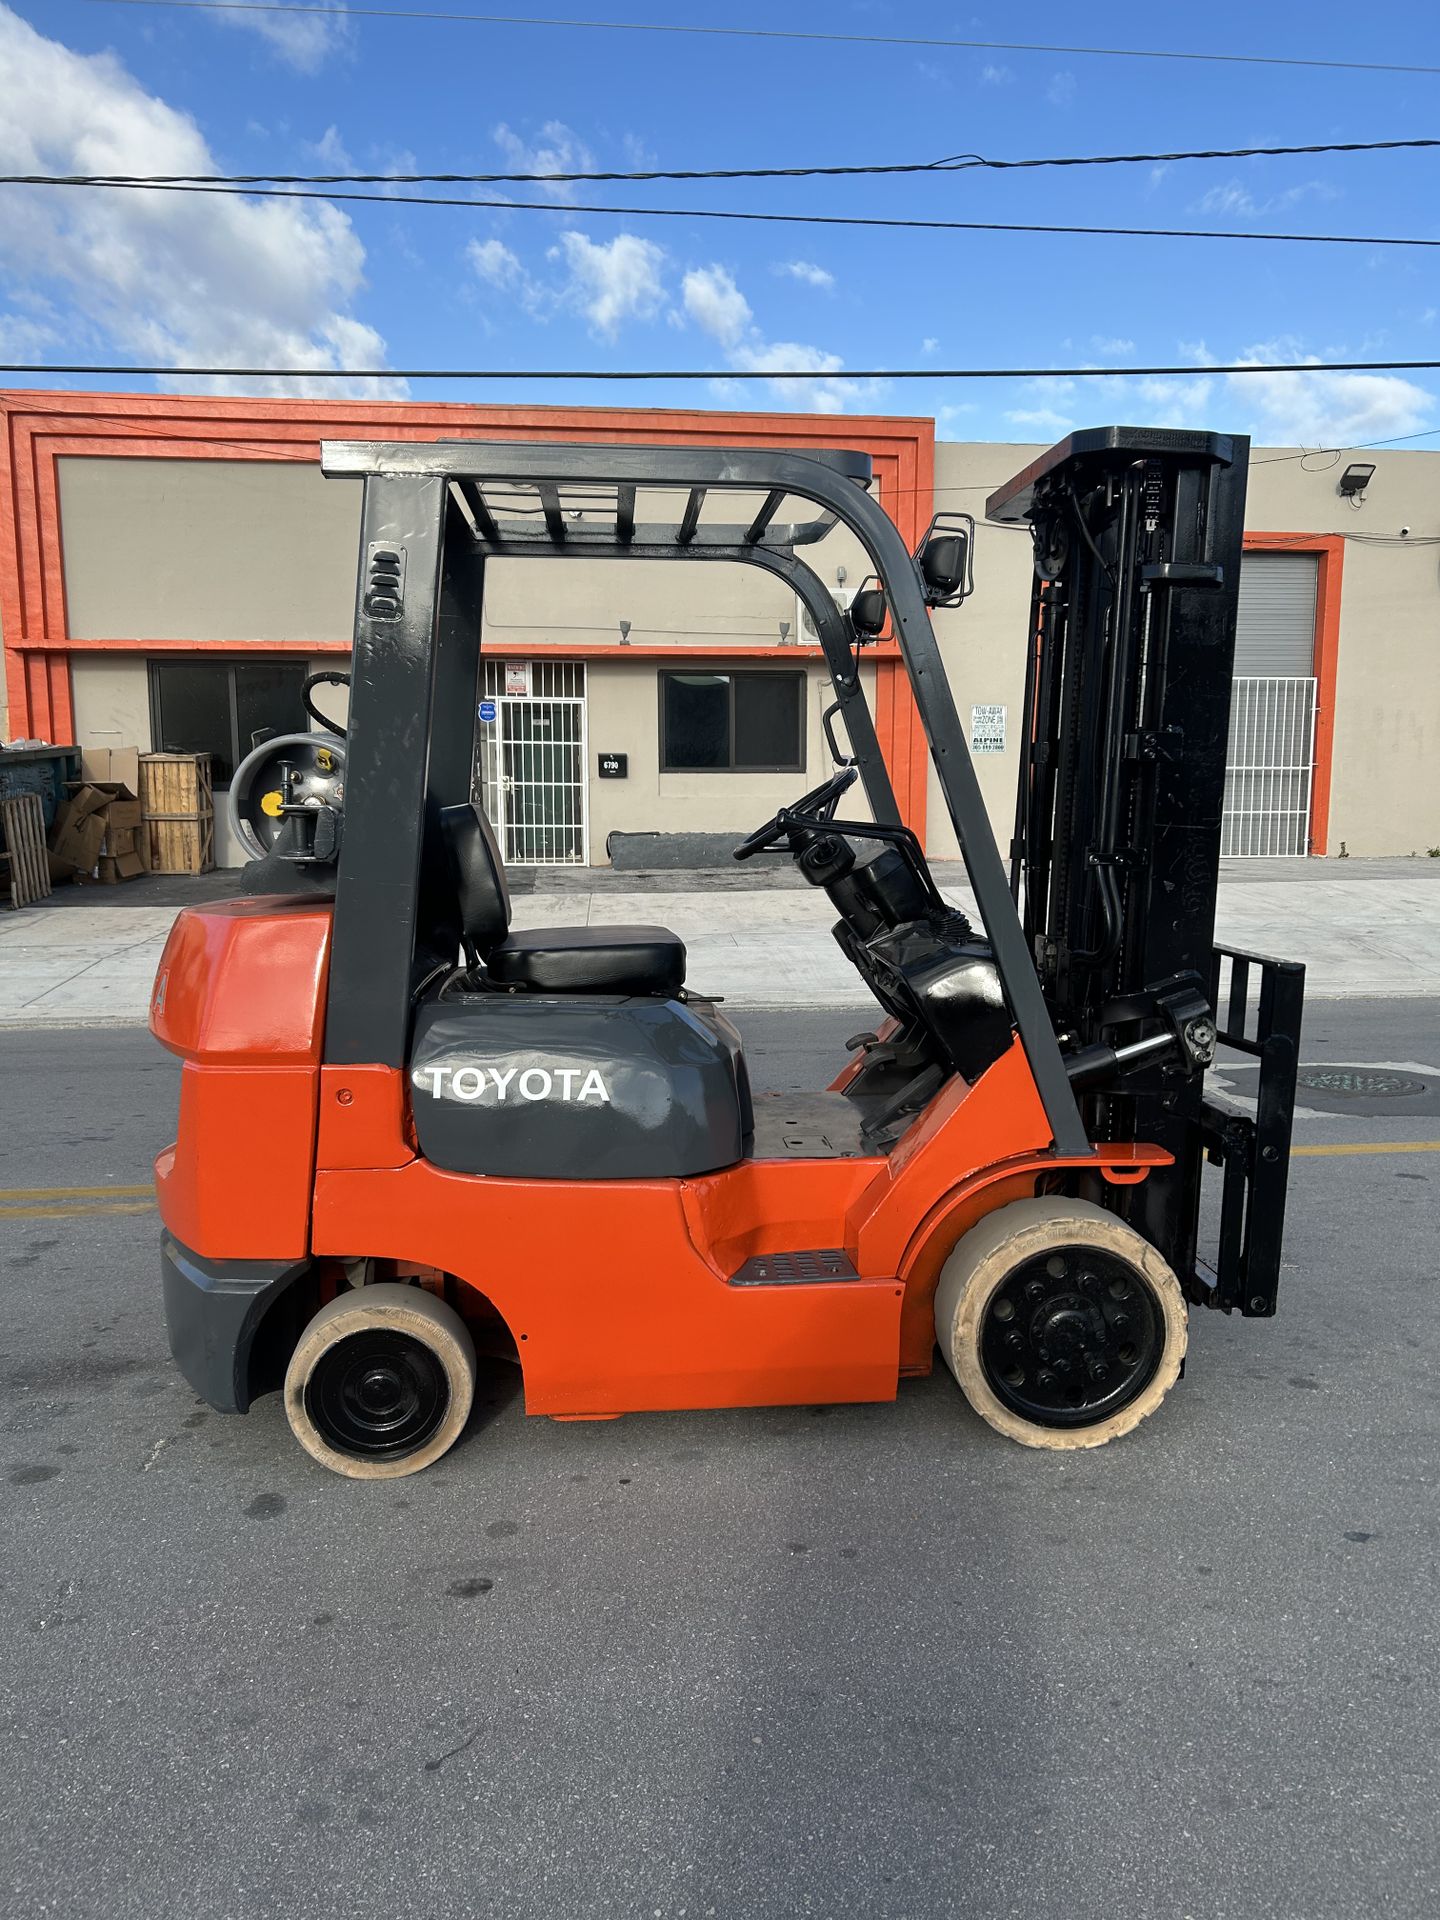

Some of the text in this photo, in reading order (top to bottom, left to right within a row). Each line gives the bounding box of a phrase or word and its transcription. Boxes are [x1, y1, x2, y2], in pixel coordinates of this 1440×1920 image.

[975, 706, 1002, 715] TOW-AWAY
[982, 715, 996, 724] ZONE
[603, 761, 619, 769] 6790
[424, 1067, 610, 1101] TOYOTA
